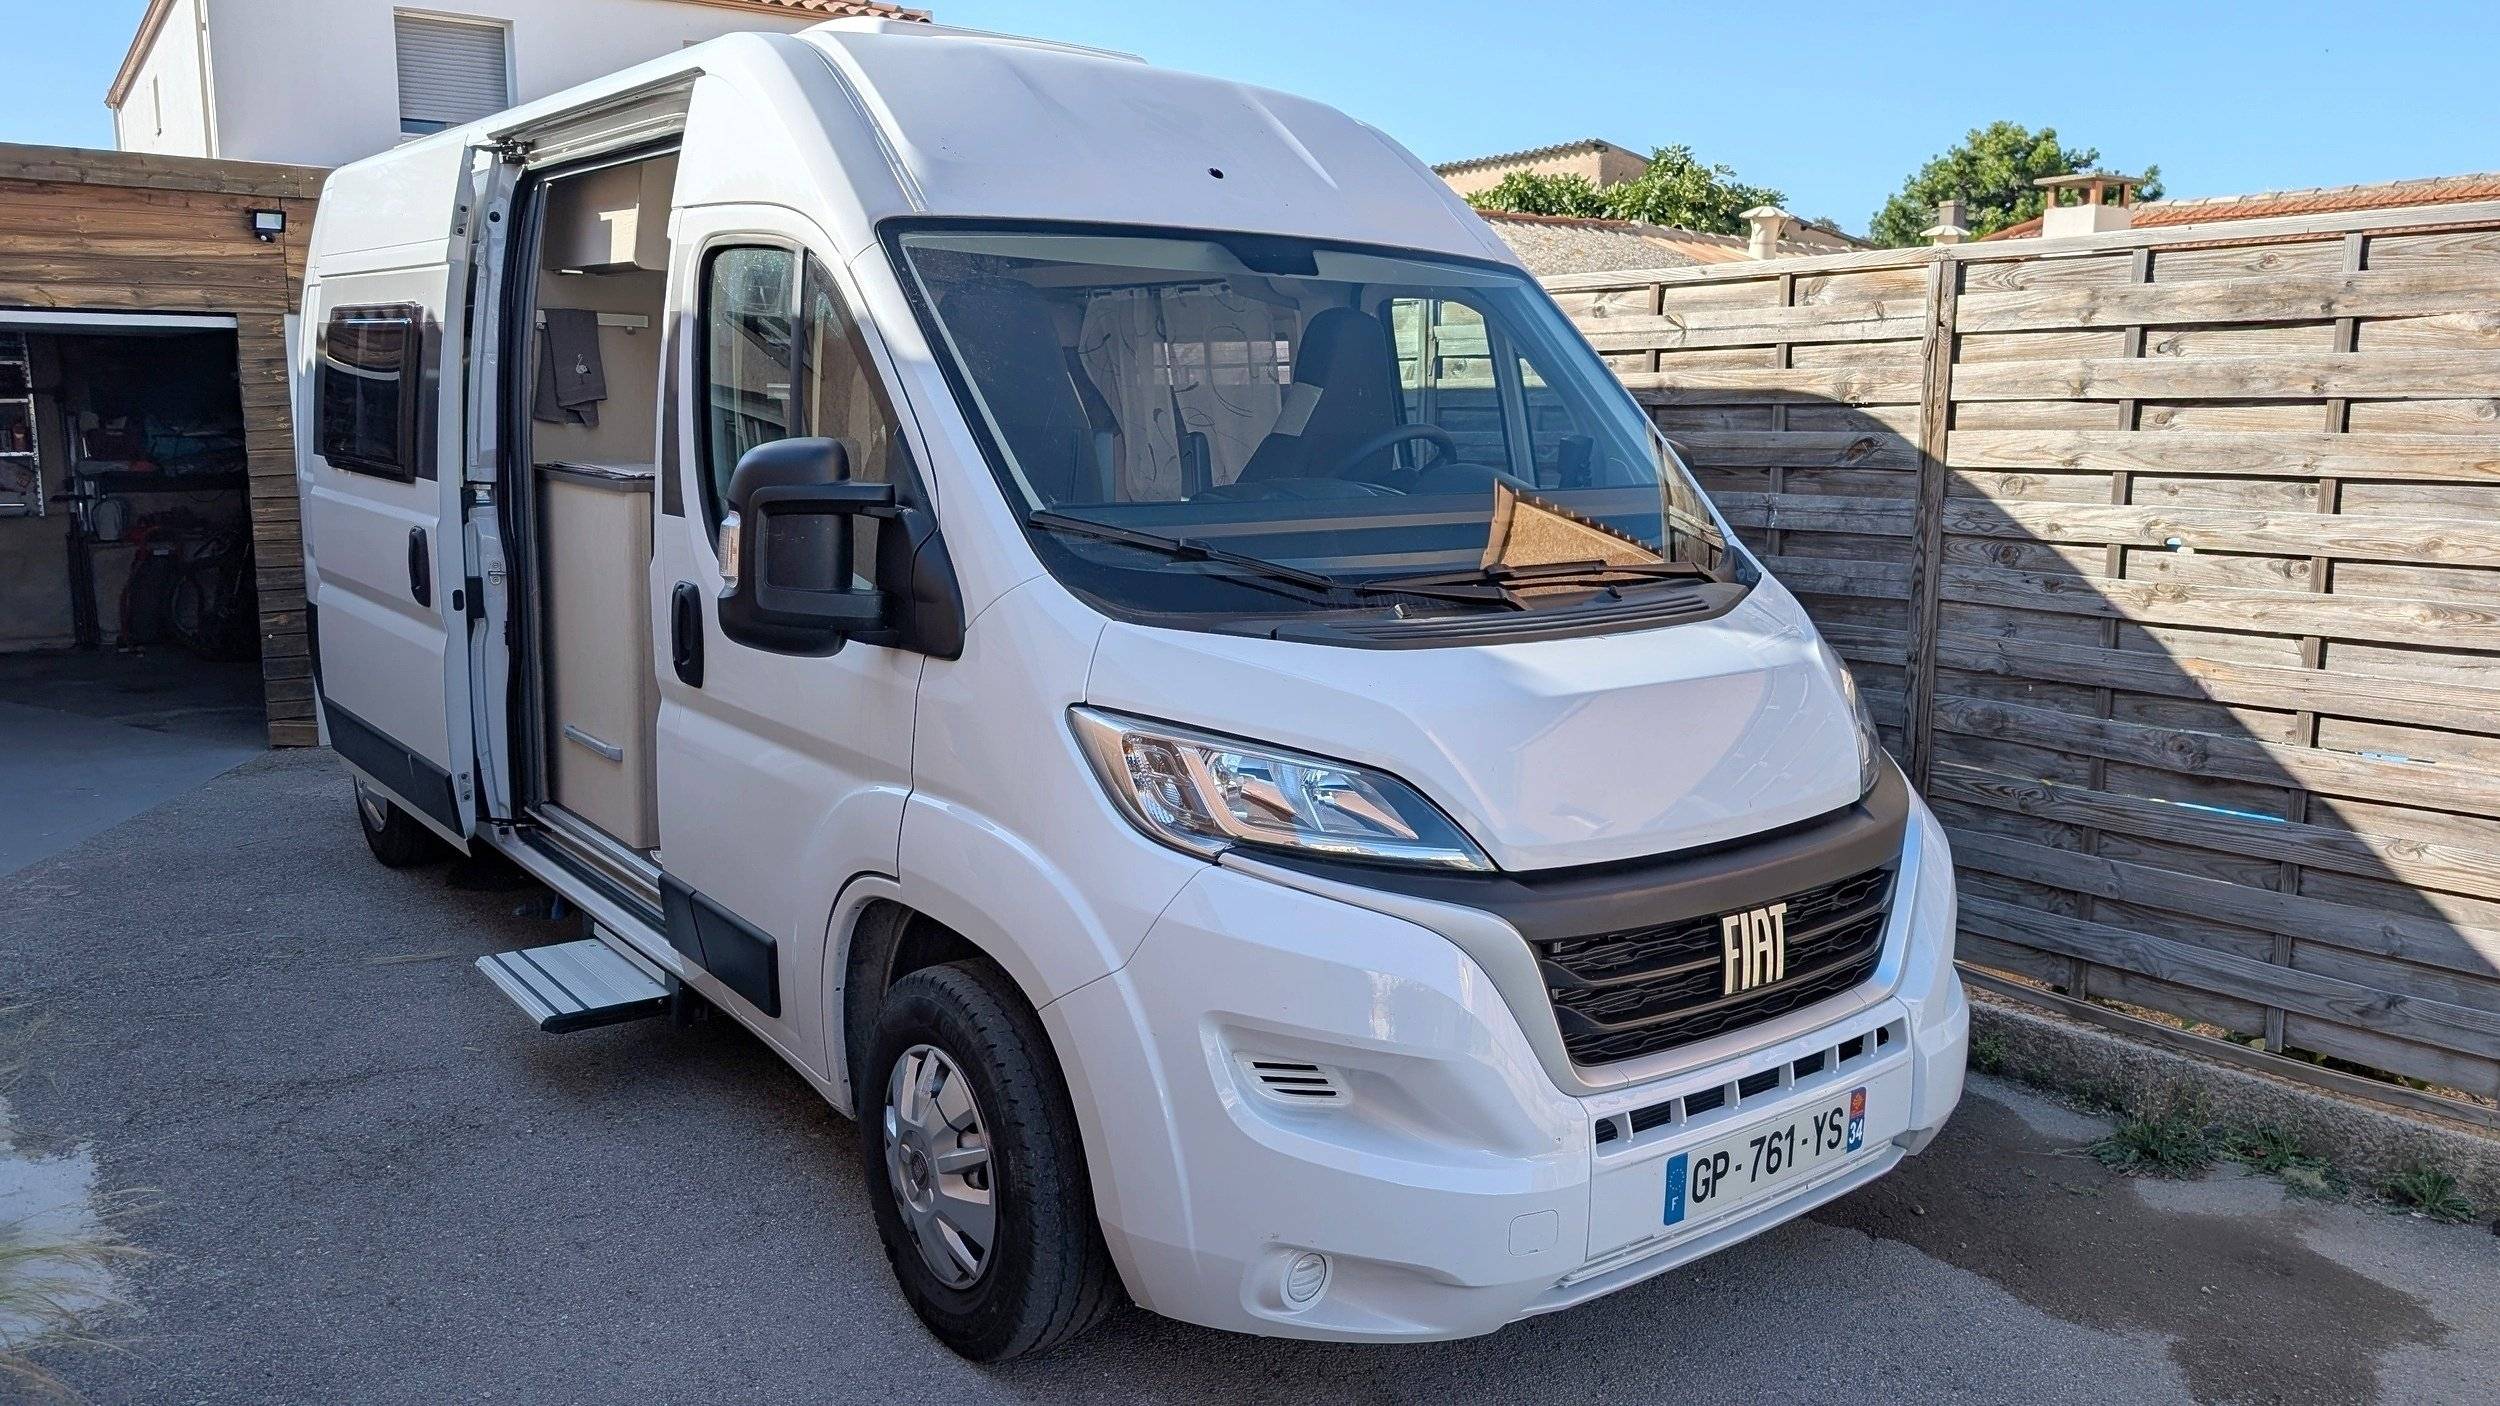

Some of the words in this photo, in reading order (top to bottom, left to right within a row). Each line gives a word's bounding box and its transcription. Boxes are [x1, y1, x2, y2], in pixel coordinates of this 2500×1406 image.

[1722, 903, 1787, 995] FIAT
[1692, 1107, 1843, 1203] GP-761-YS
[1849, 1118, 1863, 1144] 34
[1671, 1196, 1679, 1211] F
